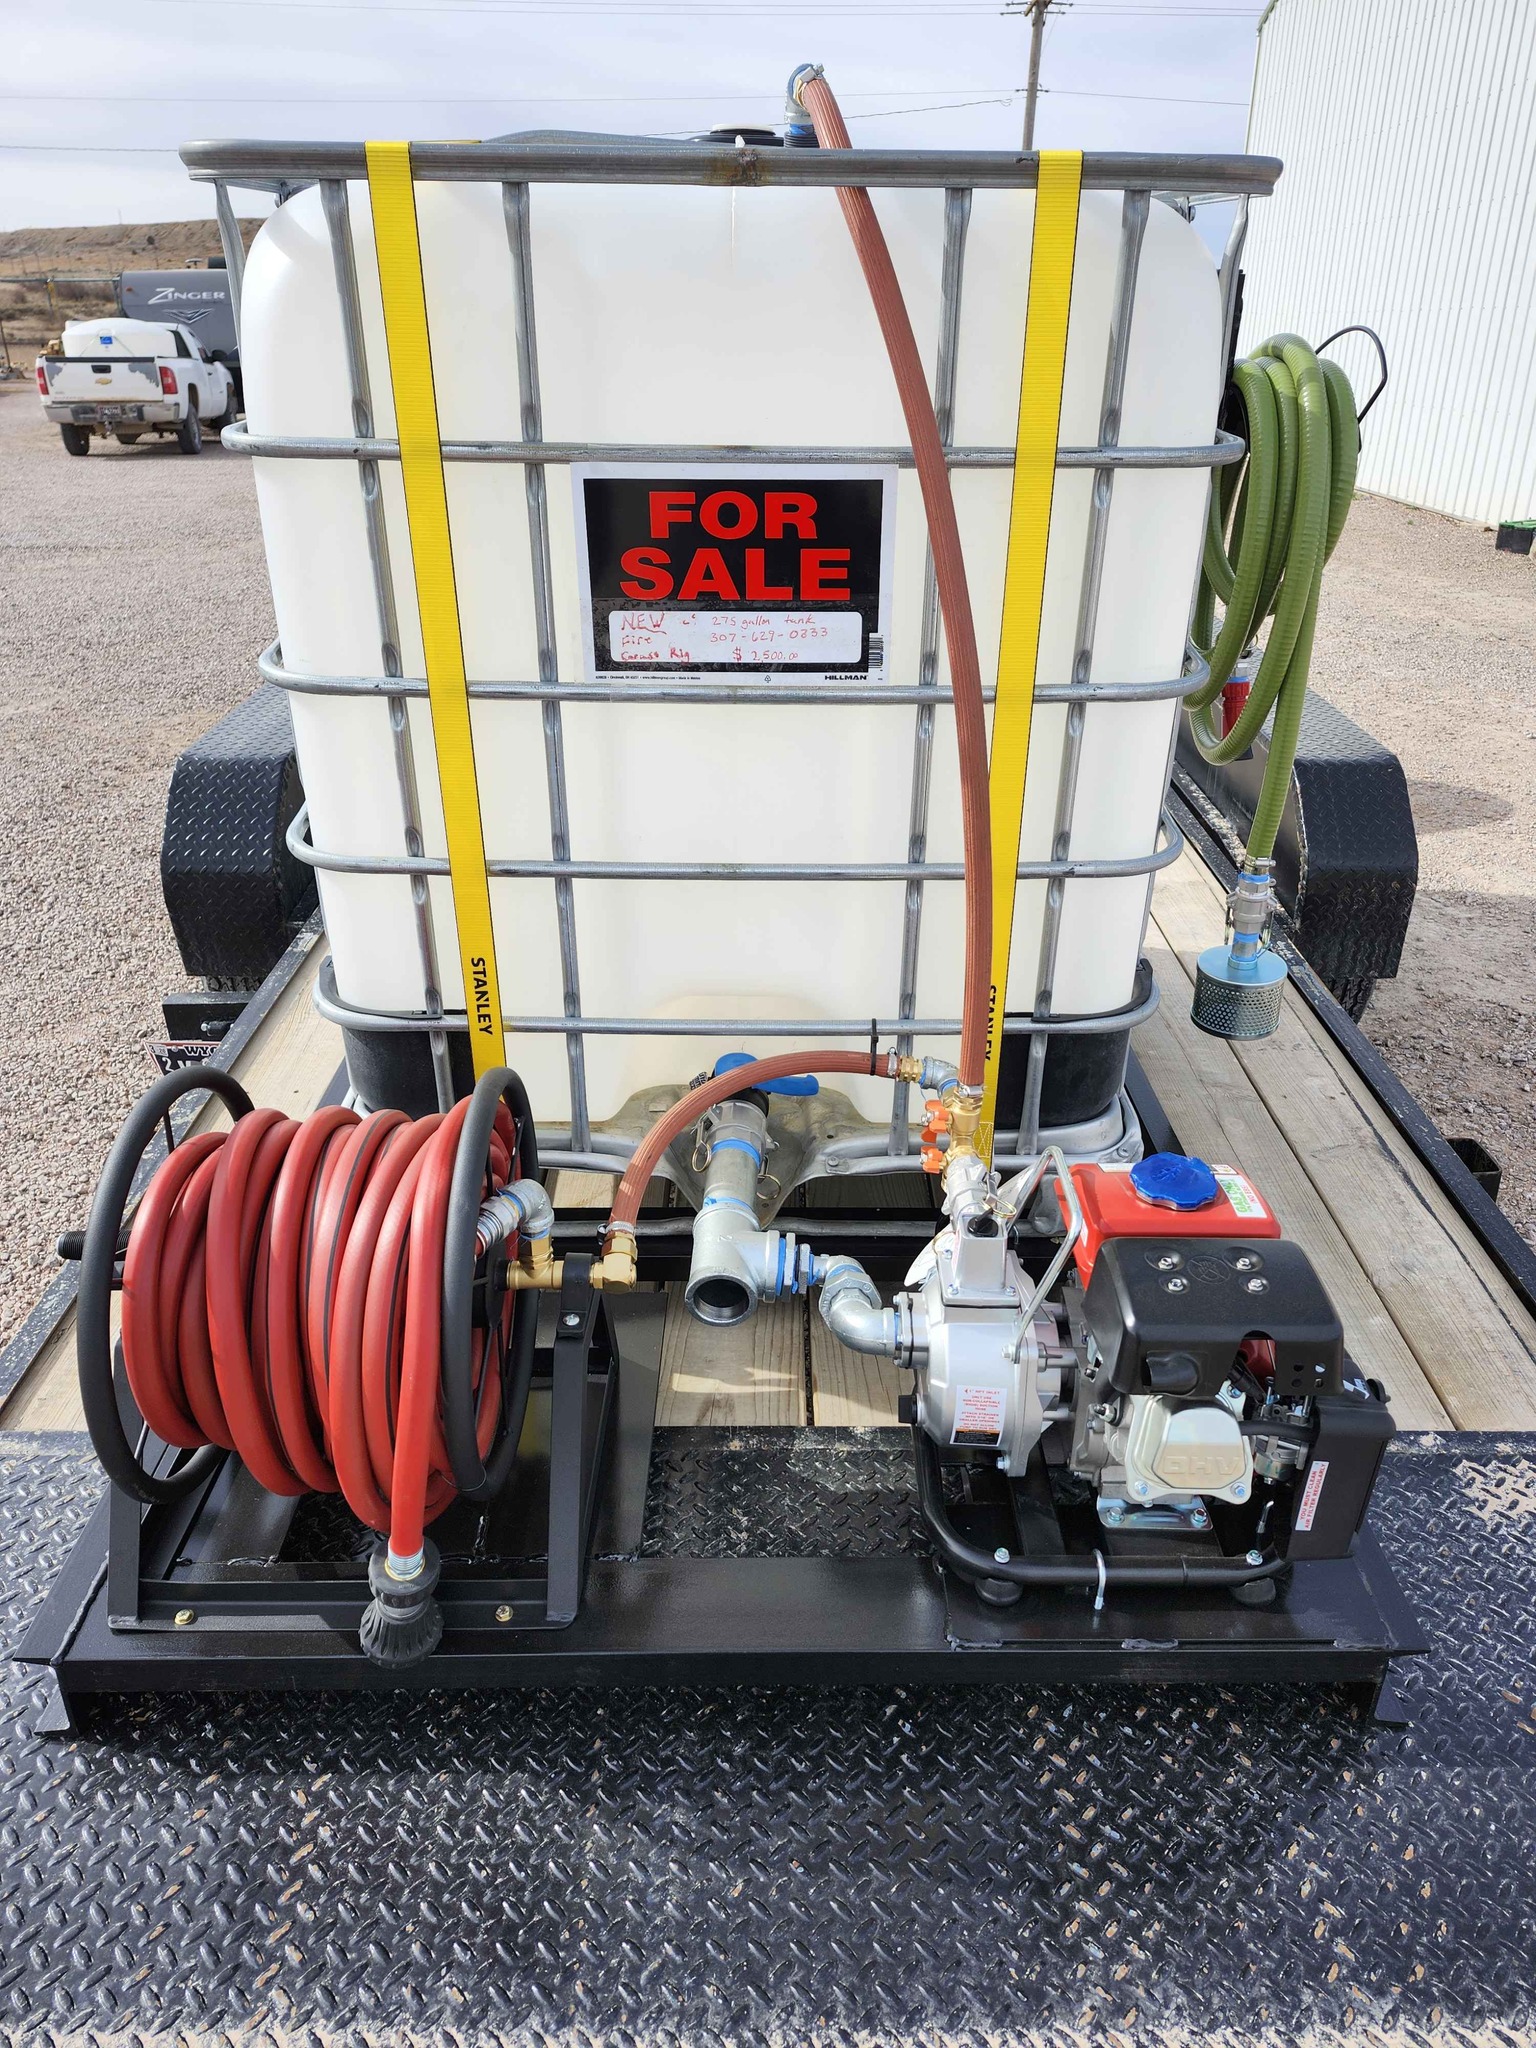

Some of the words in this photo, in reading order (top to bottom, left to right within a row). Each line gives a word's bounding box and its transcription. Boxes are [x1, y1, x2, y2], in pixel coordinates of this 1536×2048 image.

[148, 288, 225, 304] ZINGER
[649, 491, 818, 540] FOR
[619, 547, 850, 601] SALE
[621, 612, 665, 630] NEW
[712, 616, 736, 626] 275
[741, 615, 770, 630] gallon
[784, 614, 815, 624] tank
[471, 957, 493, 1035] STANLEY
